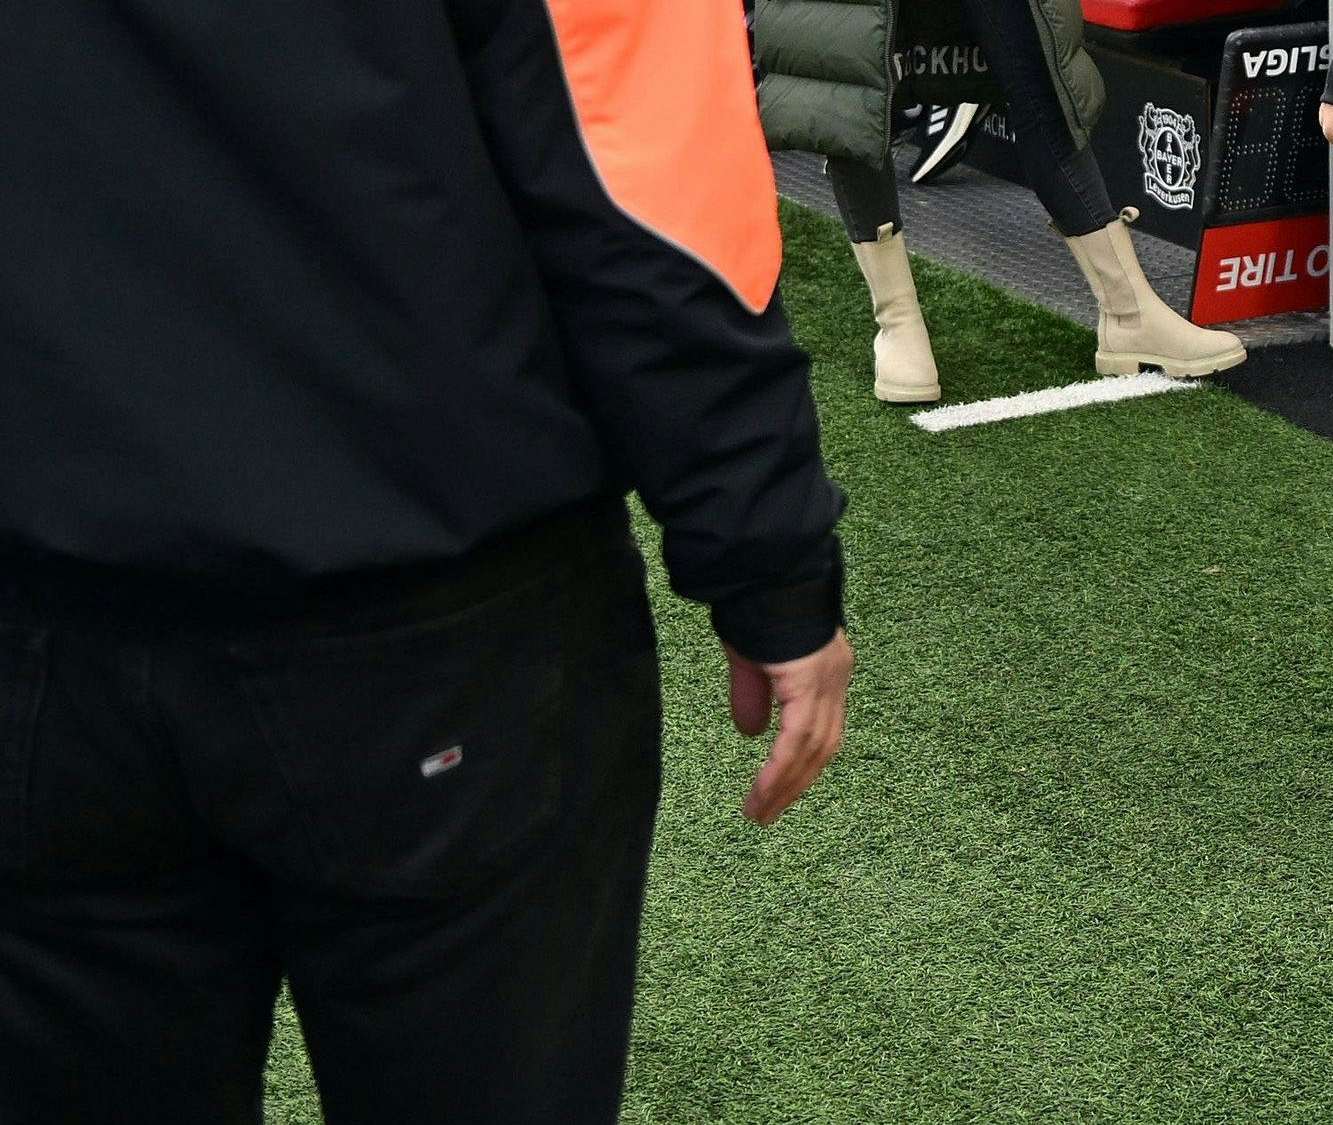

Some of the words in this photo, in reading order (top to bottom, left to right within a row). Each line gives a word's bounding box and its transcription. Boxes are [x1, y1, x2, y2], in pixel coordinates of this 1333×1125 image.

[1156, 149, 1183, 167] BAYER
[1148, 177, 1190, 204] Leverkusen
[1216, 249, 1298, 292] TIRE
